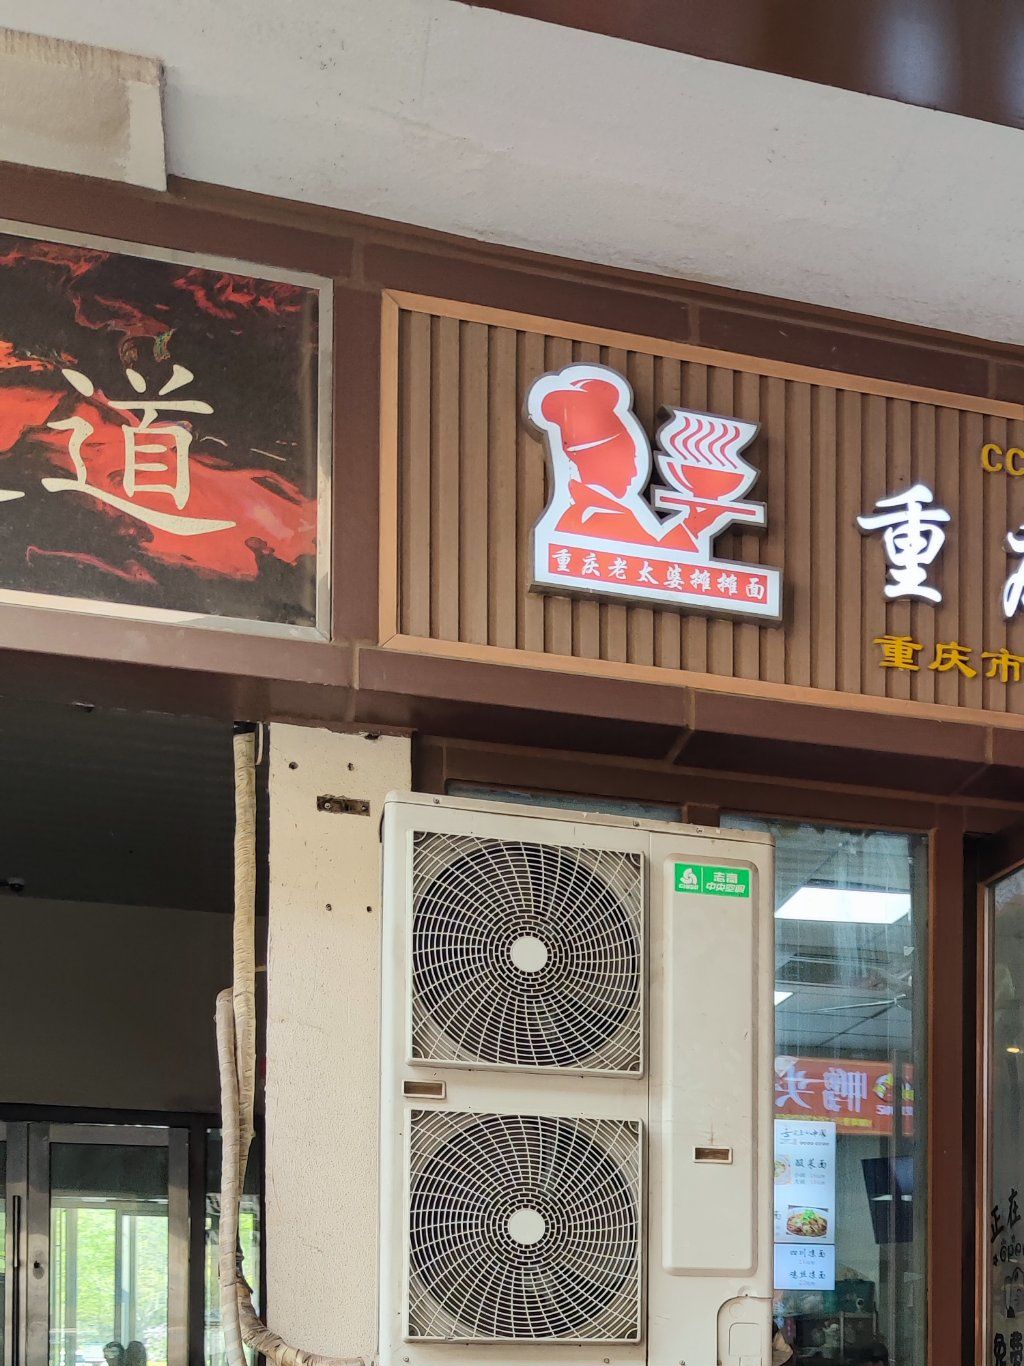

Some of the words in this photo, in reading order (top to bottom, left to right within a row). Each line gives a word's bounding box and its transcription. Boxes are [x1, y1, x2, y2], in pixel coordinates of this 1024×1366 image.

[0, 364, 236, 537] 道
[551, 549, 765, 600] 重庆老太婆摊摊面
